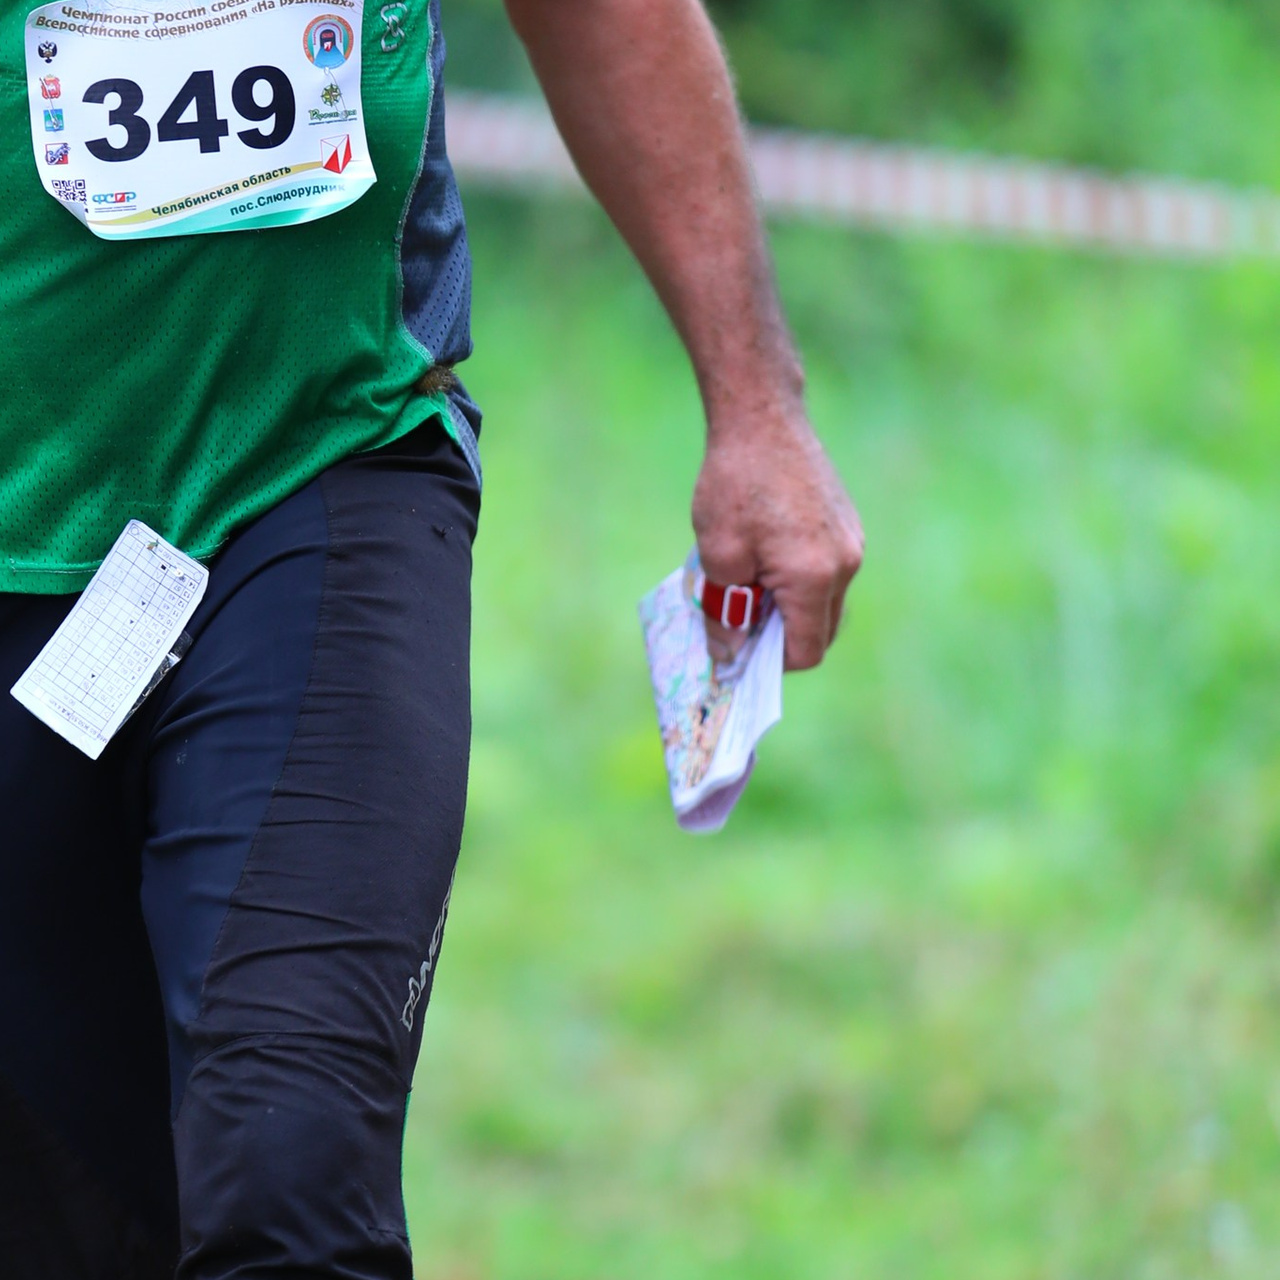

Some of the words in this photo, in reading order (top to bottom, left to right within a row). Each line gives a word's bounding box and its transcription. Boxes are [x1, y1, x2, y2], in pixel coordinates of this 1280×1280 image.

[35, 15, 140, 39] Всероссийские
[144, 8, 248, 39] соревнования
[60, 5, 149, 25] Чемпионат
[154, 5, 207, 24] России
[81, 64, 297, 163] 349
[151, 180, 240, 217] Челябинская
[242, 165, 292, 190] область
